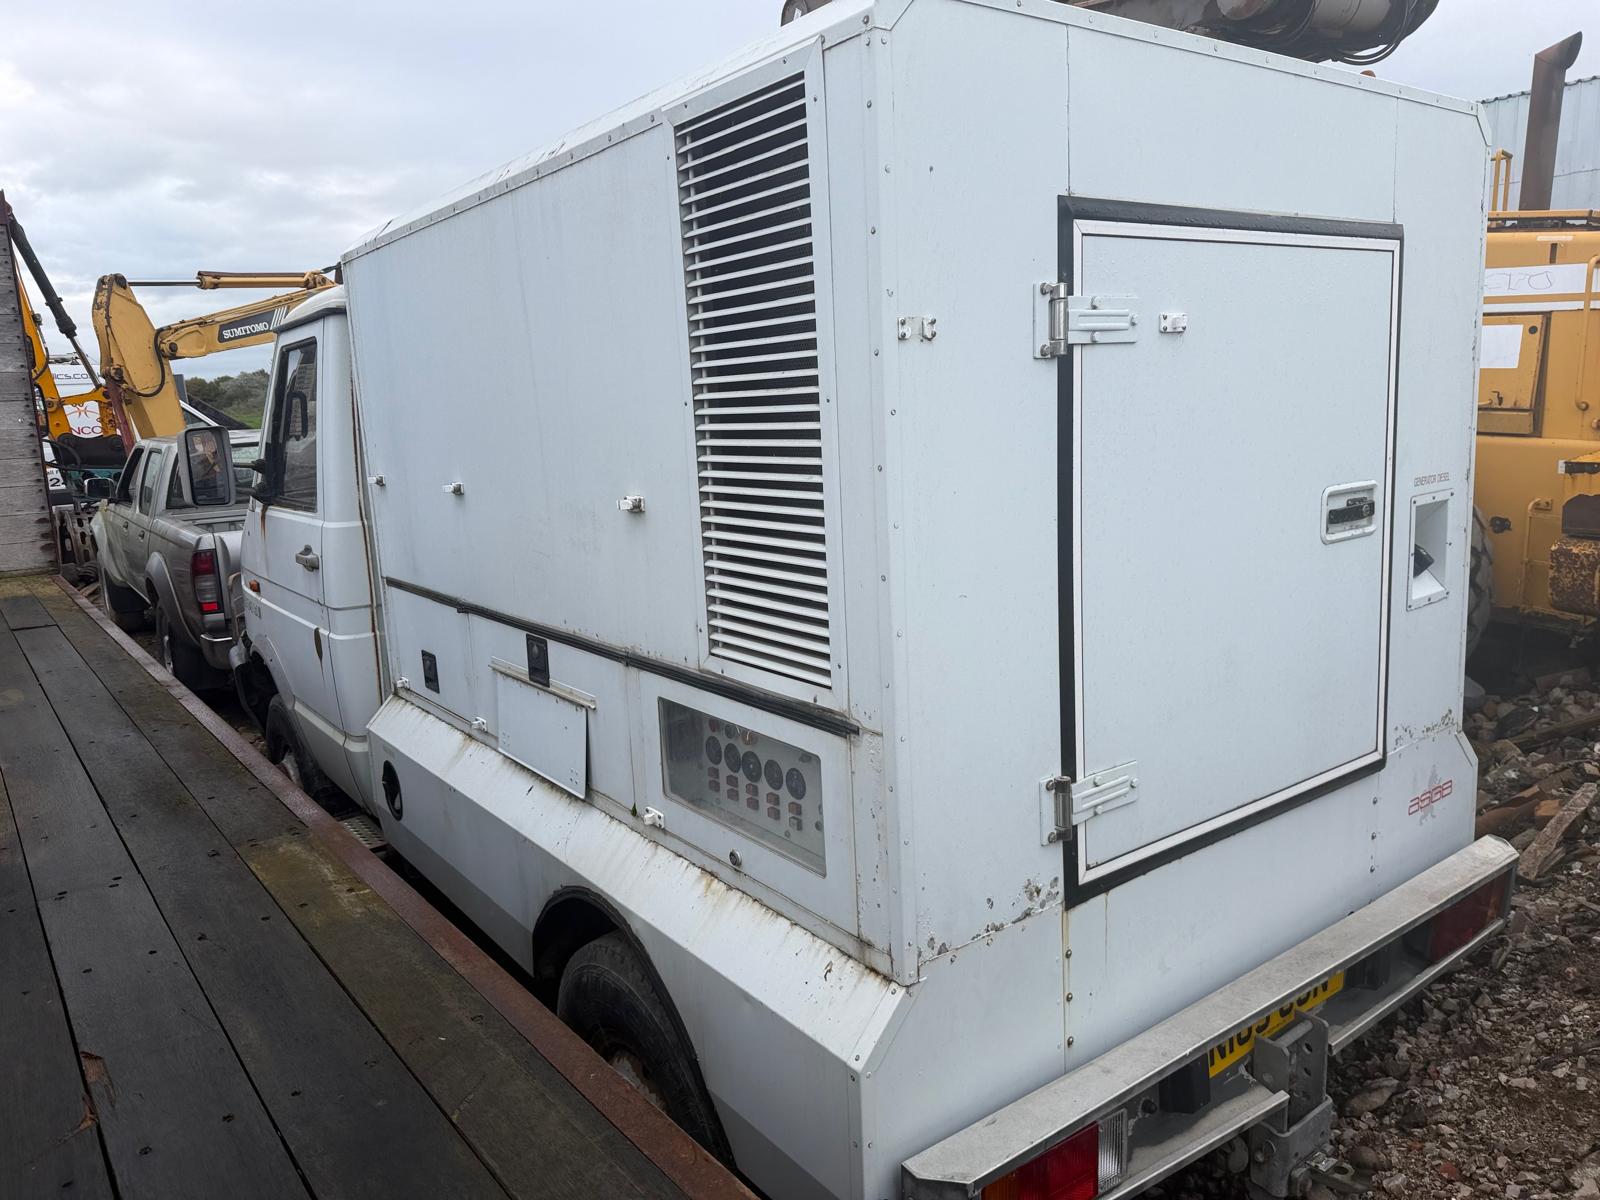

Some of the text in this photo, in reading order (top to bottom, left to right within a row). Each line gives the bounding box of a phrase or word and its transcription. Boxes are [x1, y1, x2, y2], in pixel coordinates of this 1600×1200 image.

[222, 321, 269, 339] SUMITOMO
[71, 425, 103, 436] NCO
[1413, 471, 1450, 487] GENERATOR DIESEL
